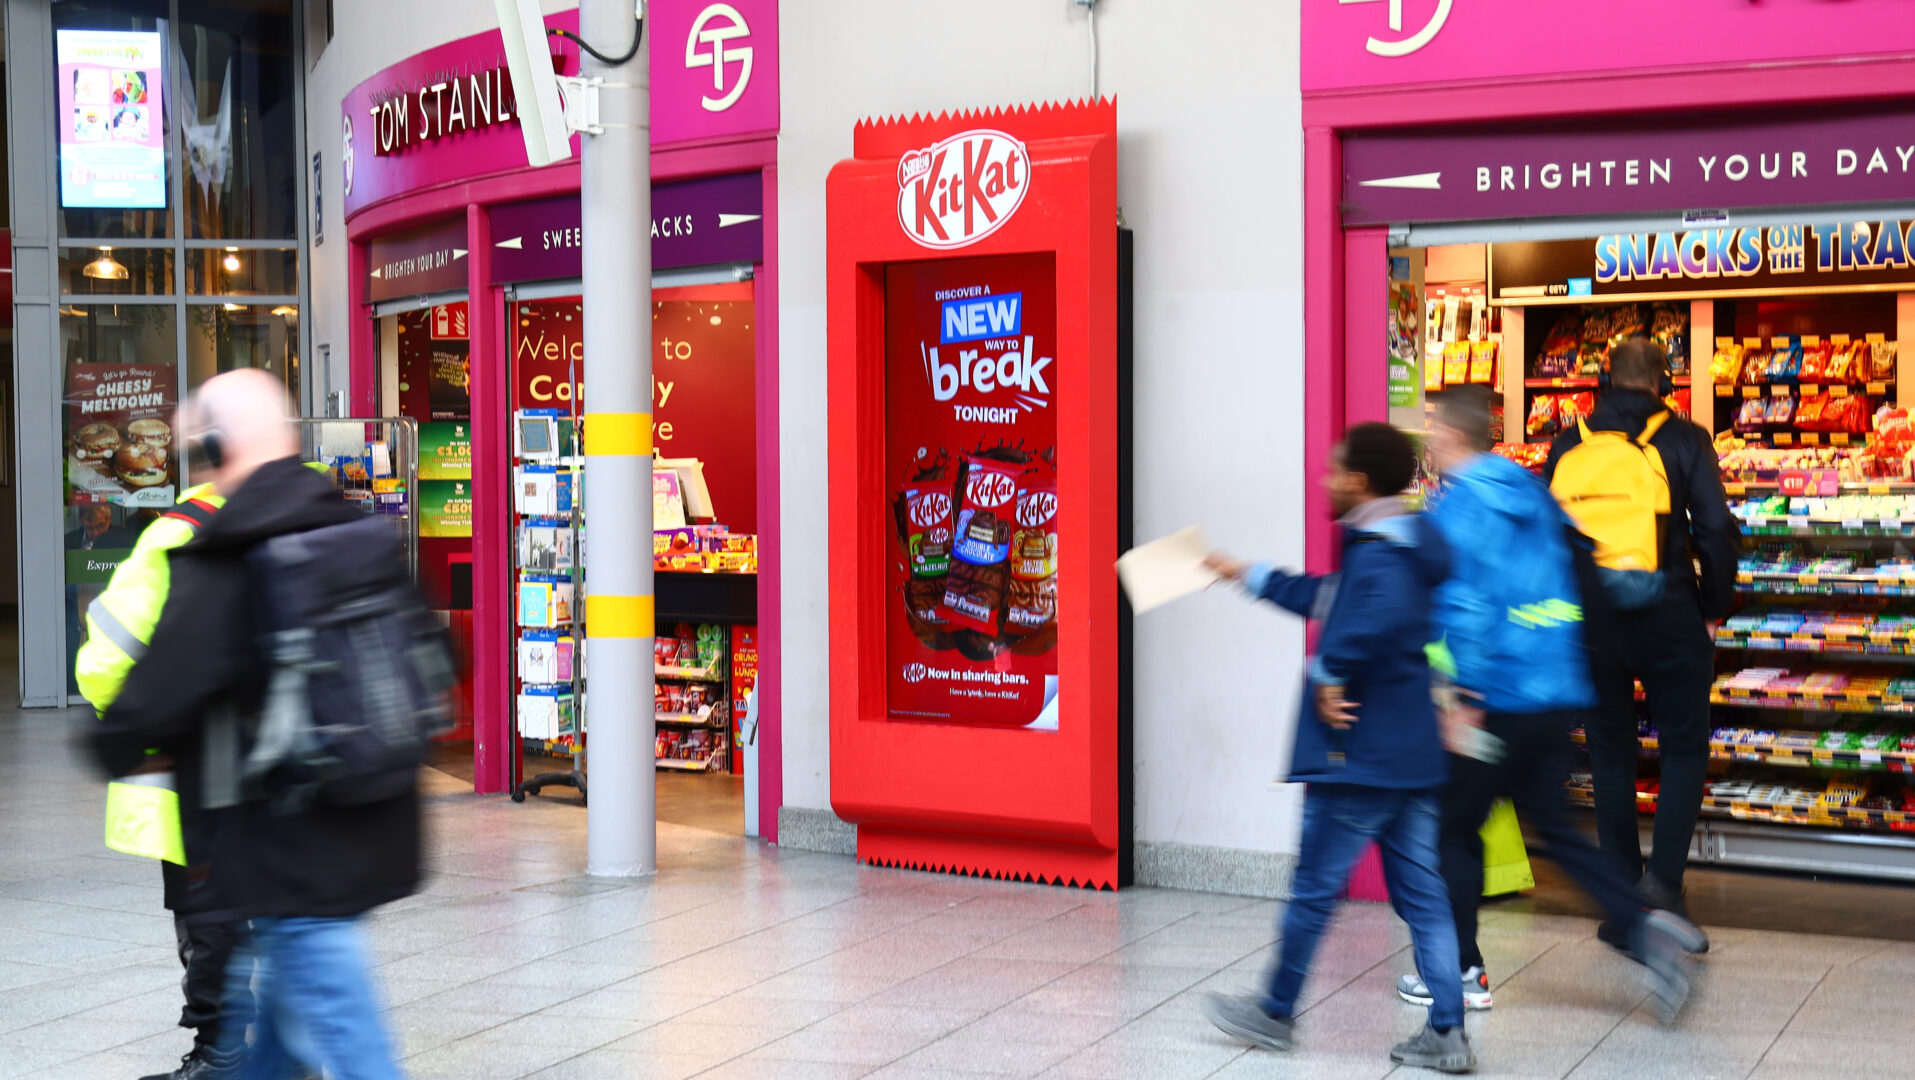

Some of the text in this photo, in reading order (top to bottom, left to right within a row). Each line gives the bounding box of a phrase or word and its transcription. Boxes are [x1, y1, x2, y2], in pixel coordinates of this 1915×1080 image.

[370, 67, 520, 156] TOM STANL
[1476, 144, 1915, 192] BRIGHTEN YOUR DAY
[914, 138, 1020, 241] KitKat
[1767, 224, 1805, 250] ON
[385, 248, 449, 280] BRIGHTEN YOUR DAY
[1595, 228, 1763, 284] SNACKS
[1767, 249, 1805, 275] THE
[935, 284, 991, 301] DISCOVER A
[945, 298, 1018, 339] NEW
[661, 336, 692, 360] to
[985, 339, 1019, 351] WAY TO
[929, 335, 1054, 402] break
[96, 378, 152, 397] CHEESY
[81, 392, 163, 415] MELTDOWN
[954, 405, 1019, 425] TONIGHT
[970, 473, 1013, 506] KitKat
[914, 493, 949, 526] KitKat
[1020, 492, 1056, 526] KitKat
[960, 546, 995, 562] CHOCOLATE
[967, 540, 991, 551] DOUBLE
[920, 562, 948, 572] HAZELNUT
[928, 667, 950, 680] Now
[951, 668, 960, 680] in
[962, 669, 1001, 685] sharing
[1002, 671, 1029, 685] bars.
